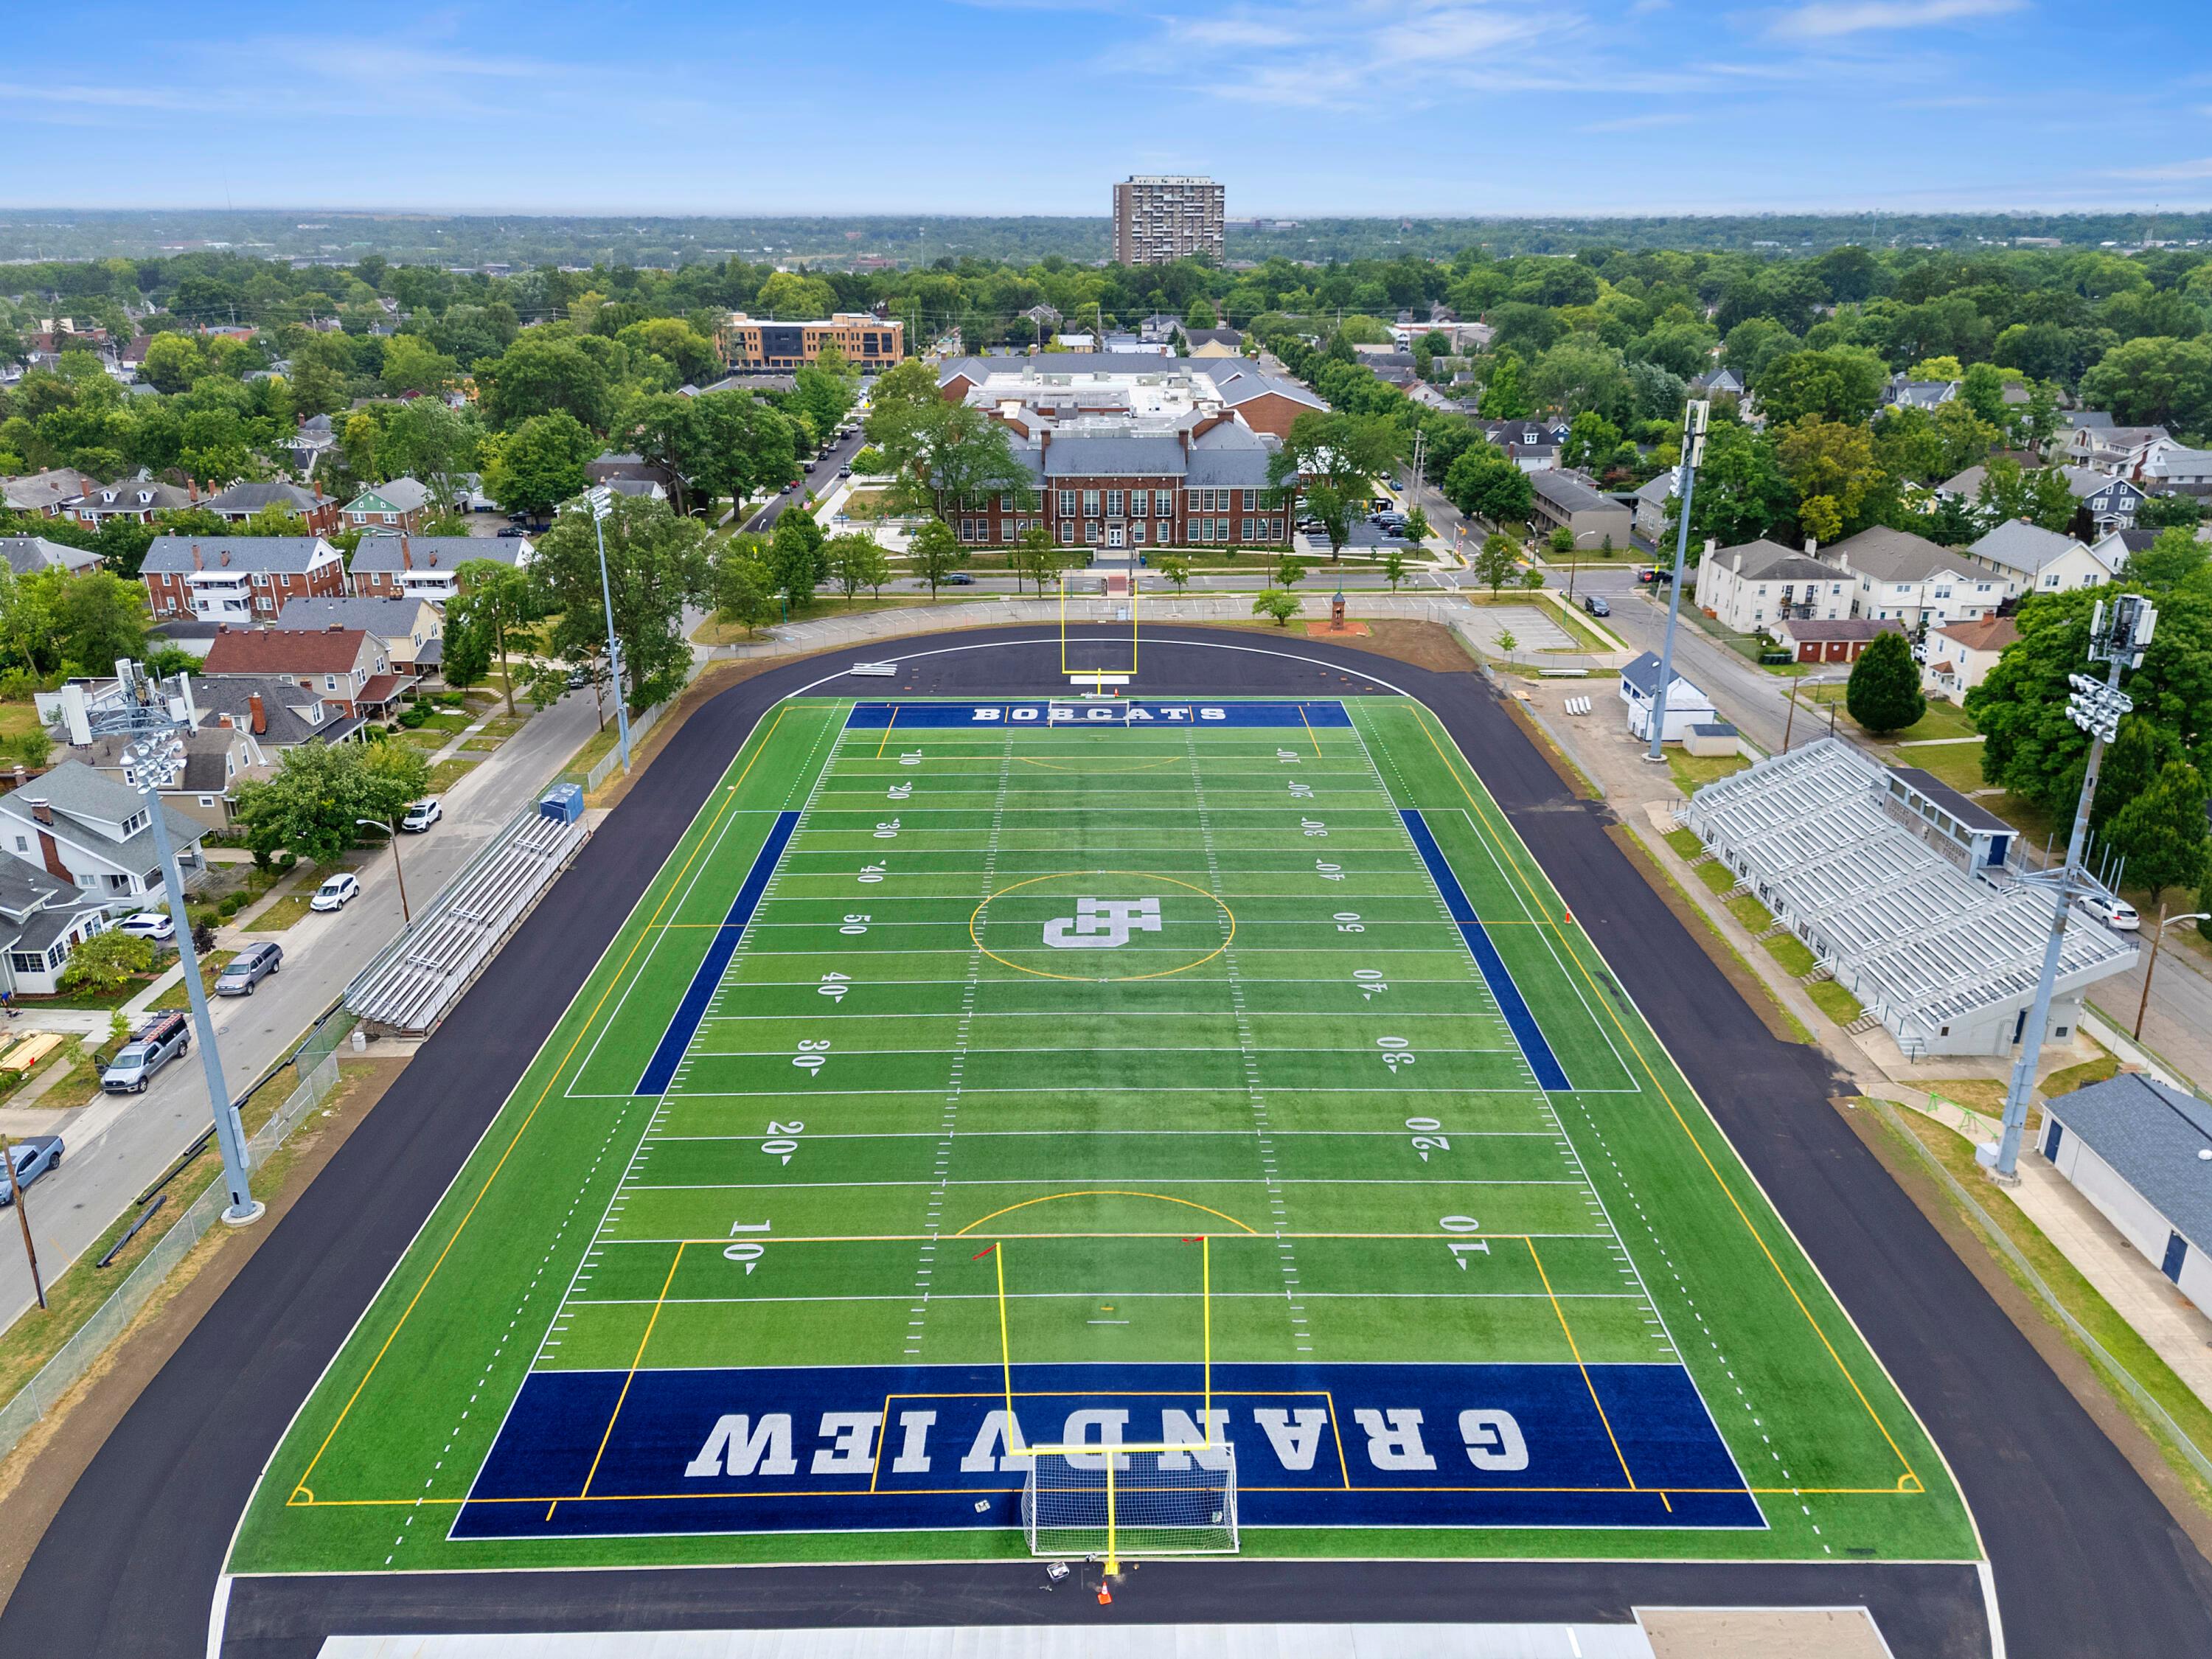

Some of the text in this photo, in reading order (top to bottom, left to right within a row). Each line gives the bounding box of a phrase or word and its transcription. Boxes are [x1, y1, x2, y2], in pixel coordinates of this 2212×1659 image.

[972, 708, 1226, 720] BOBCATS
[899, 751, 922, 765] 10
[1276, 751, 1301, 764] 10
[887, 785, 912, 799] 20
[1288, 784, 1315, 799] 20
[873, 822, 900, 838] 30
[1301, 821, 1328, 837] 30
[857, 865, 886, 883] 40
[1316, 863, 1345, 881] 40
[839, 914, 872, 934] 50
[1332, 912, 1365, 933] 50
[817, 972, 852, 995] 40
[1352, 969, 1388, 992] 40
[792, 1039, 831, 1067] 30
[1377, 1036, 1416, 1064] 30
[761, 1121, 804, 1154] 20
[1405, 1117, 1450, 1151] 20
[723, 1219, 771, 1261] 10
[1439, 1215, 1491, 1256] 10
[684, 1408, 1531, 1477] GRANDVIEW
